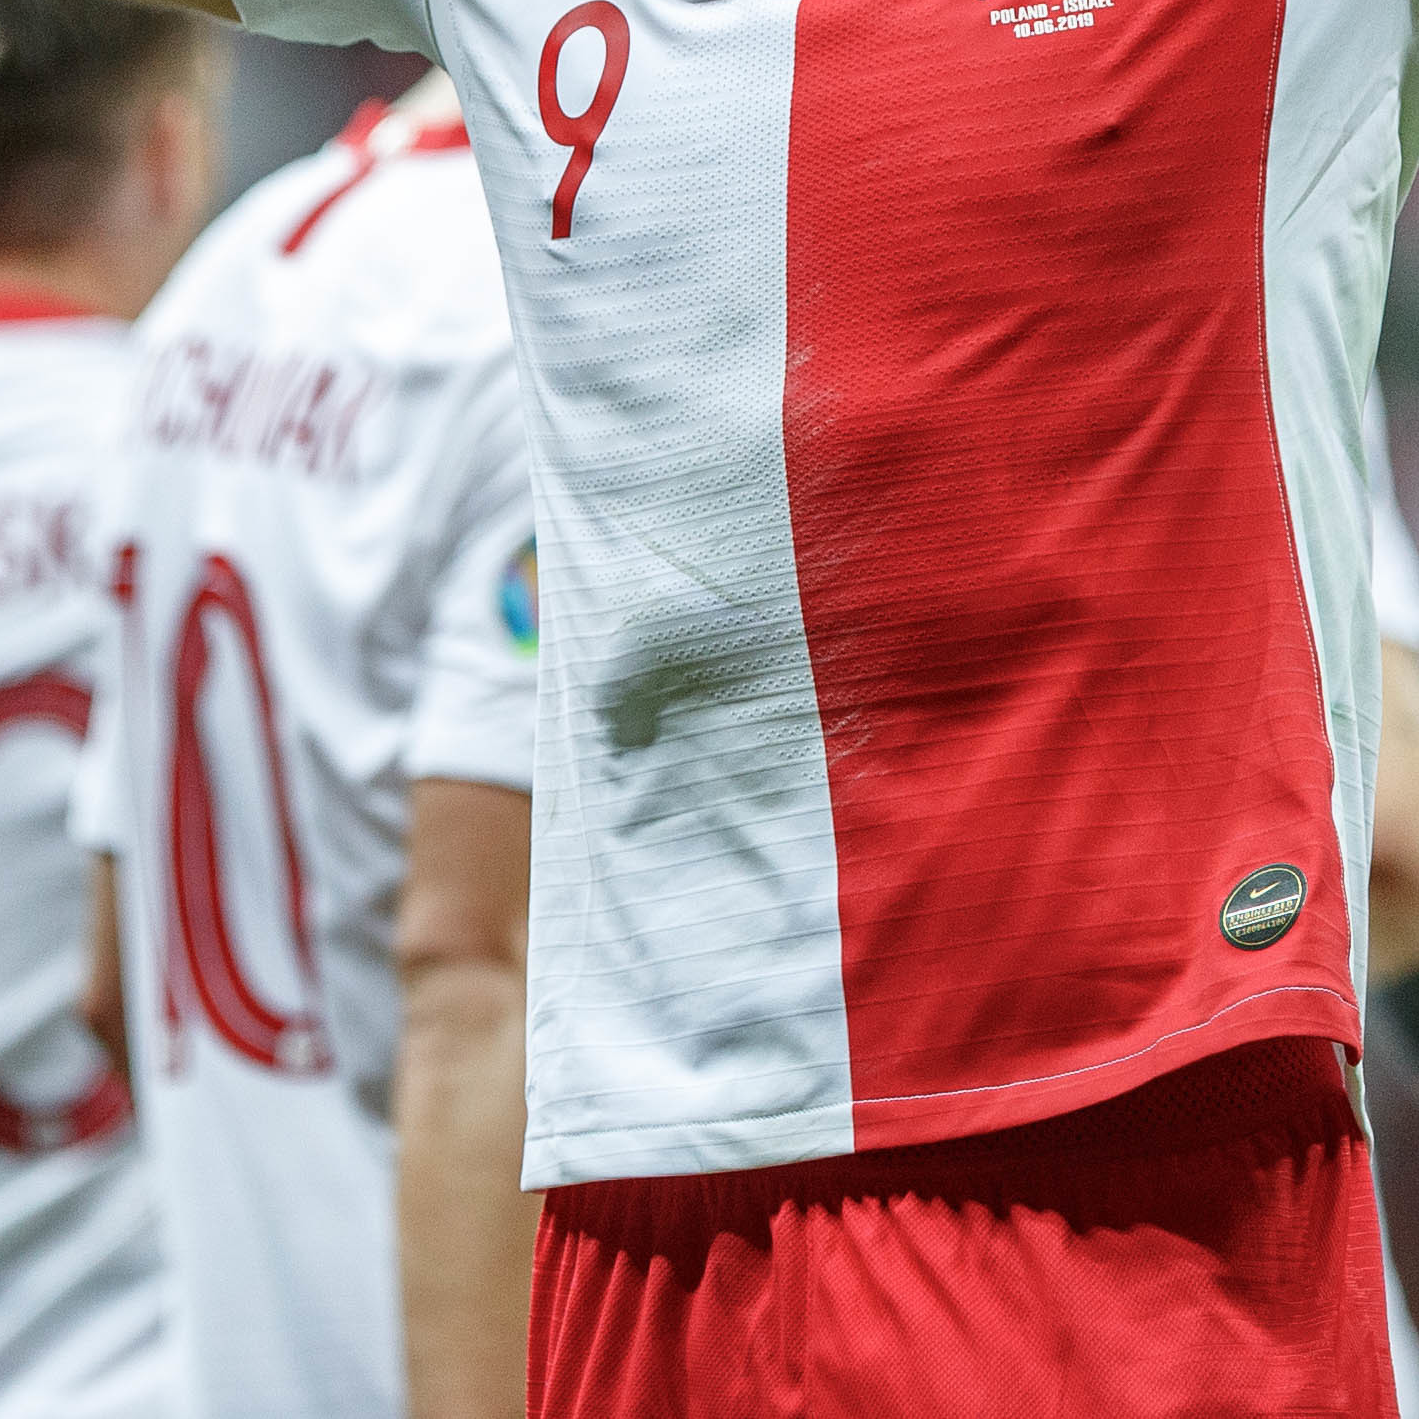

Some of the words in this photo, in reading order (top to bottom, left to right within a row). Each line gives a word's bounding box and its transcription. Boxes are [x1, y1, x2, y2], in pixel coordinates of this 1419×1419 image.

[990, 3, 1048, 26] POLAND
[1013, 12, 1095, 39] 10.06.2019
[537, 0, 631, 240] 9
